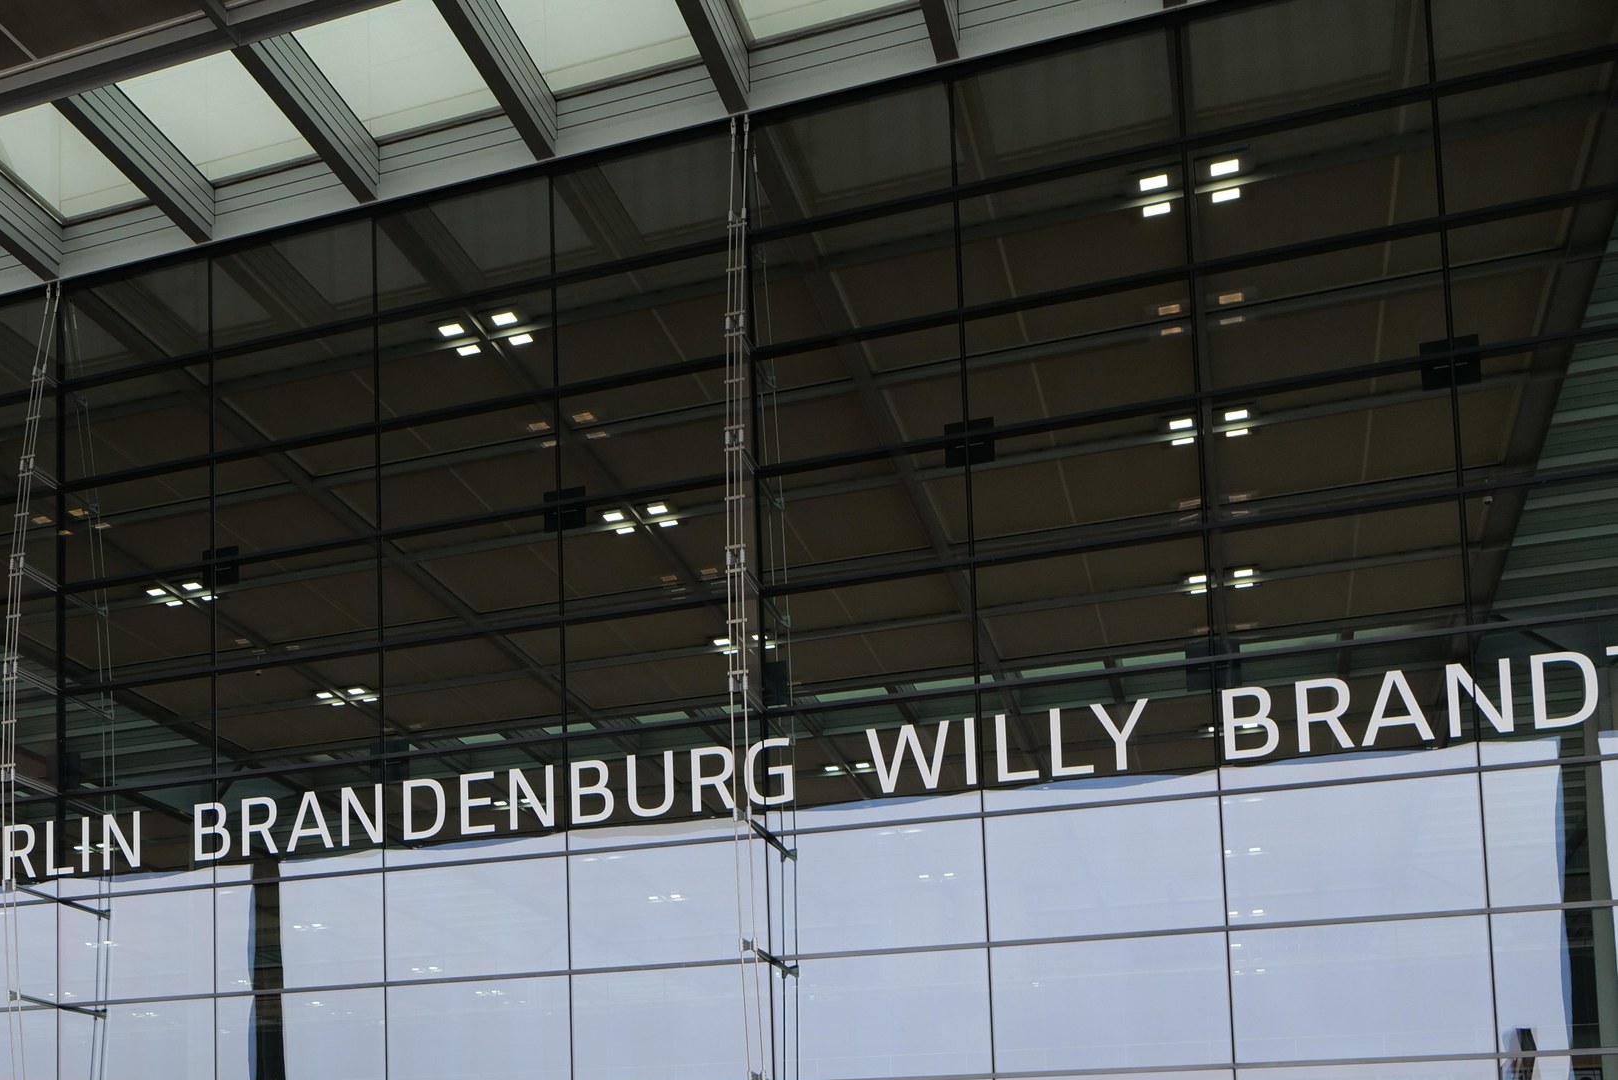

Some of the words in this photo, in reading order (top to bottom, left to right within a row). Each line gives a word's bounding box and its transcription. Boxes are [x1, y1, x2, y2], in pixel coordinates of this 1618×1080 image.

[193, 737, 795, 861] BRANDENBURG
[865, 698, 1148, 793] WILLY
[1222, 645, 1618, 760] BRAND
